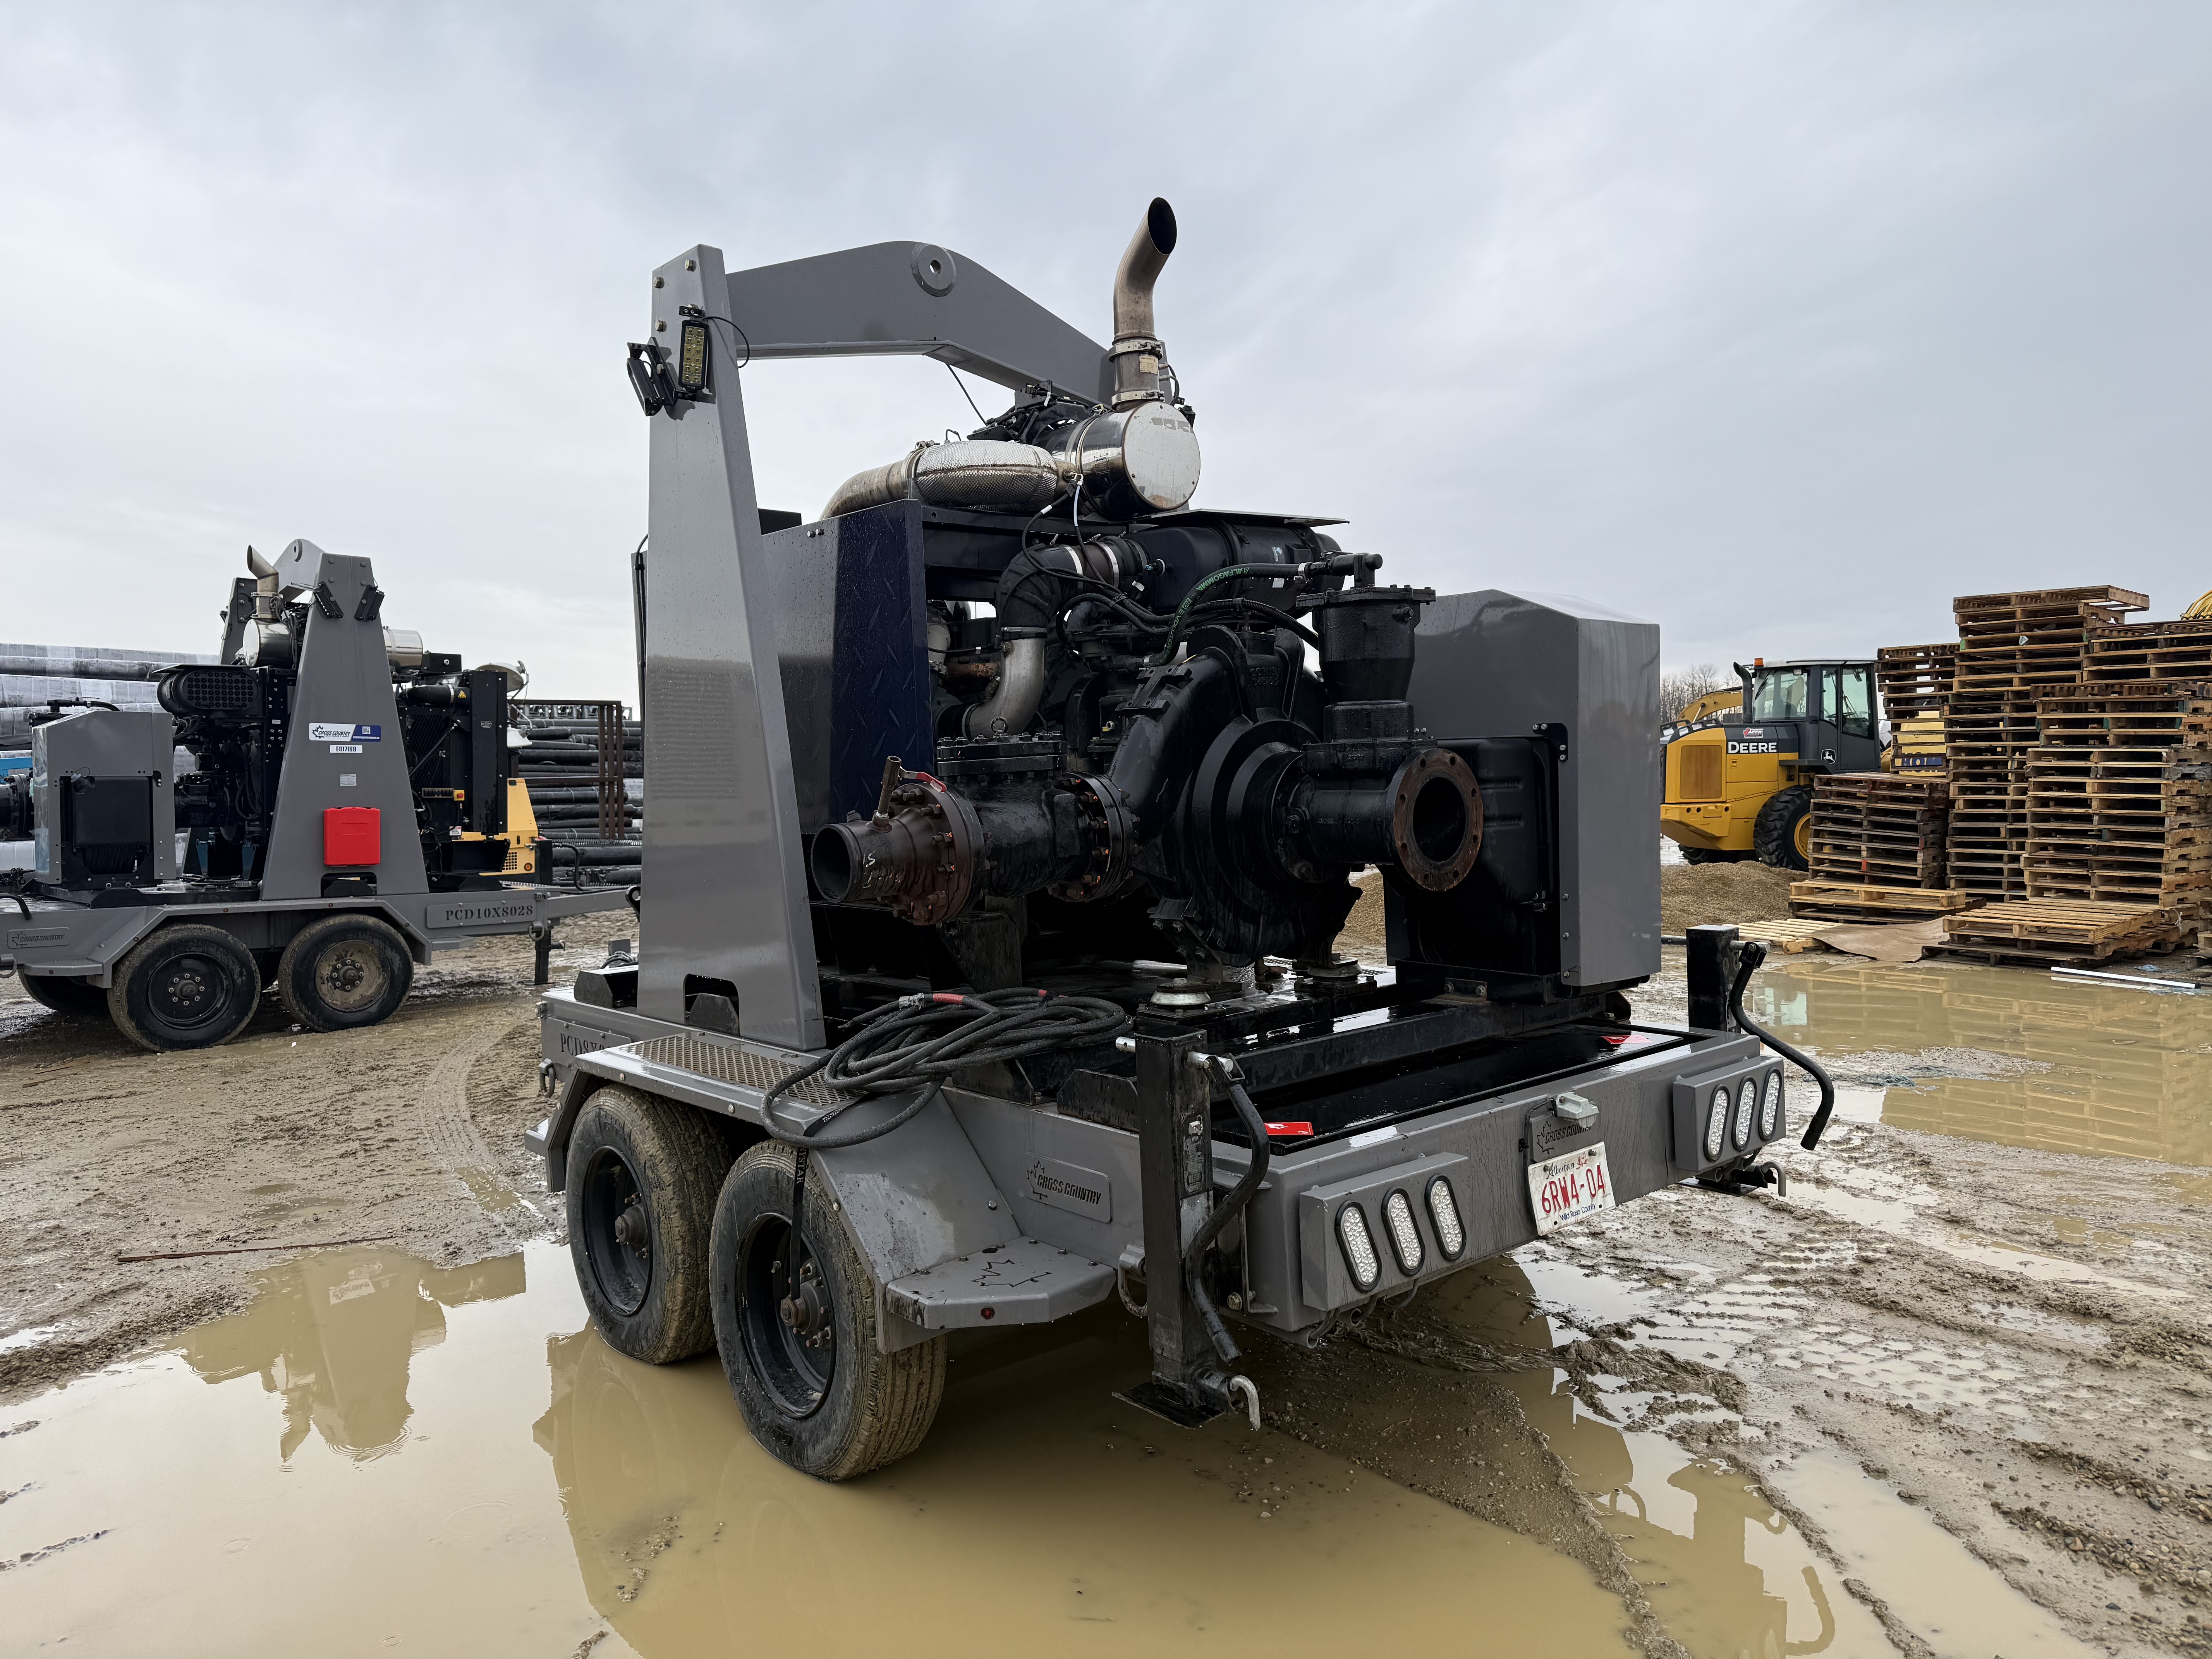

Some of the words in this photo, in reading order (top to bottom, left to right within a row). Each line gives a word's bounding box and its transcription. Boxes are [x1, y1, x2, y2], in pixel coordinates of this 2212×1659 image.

[1196, 568, 1243, 591] ALFAGOMMA
[1182, 598, 1192, 609] 202
[1728, 741, 1777, 754] DEERE
[1545, 1127, 1566, 1144] CROSS
[1037, 1175, 1064, 1194] CROSS
[1064, 1183, 1101, 1205] COUNTRY
[1559, 1212, 1570, 1221] Wild
[1581, 1203, 1596, 1213] Country
